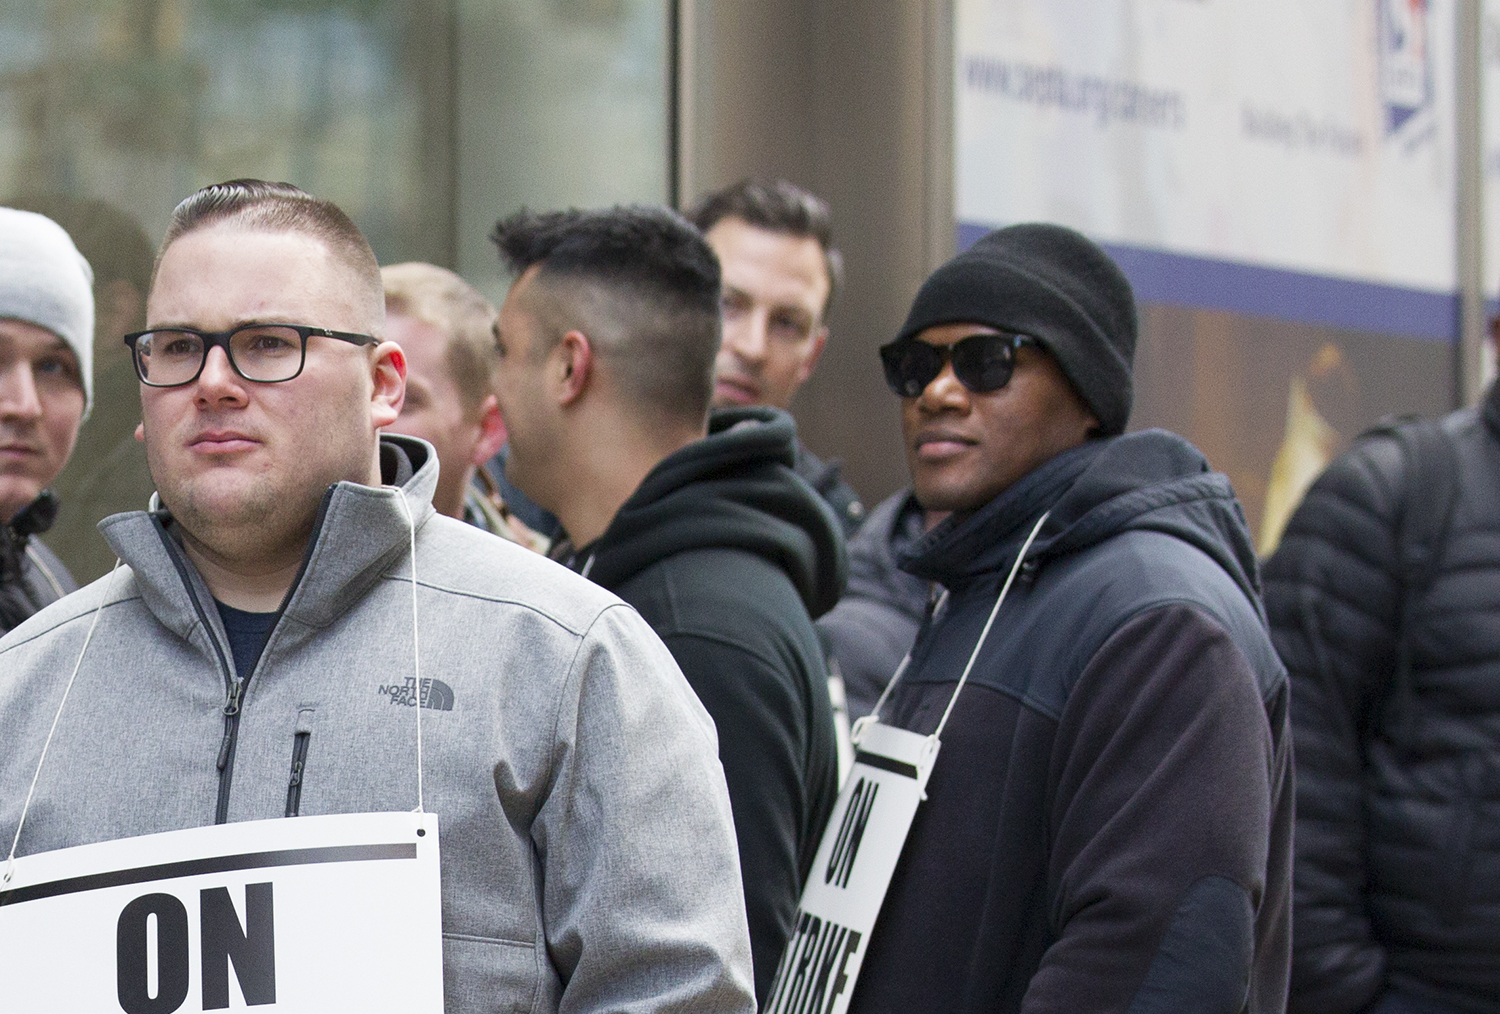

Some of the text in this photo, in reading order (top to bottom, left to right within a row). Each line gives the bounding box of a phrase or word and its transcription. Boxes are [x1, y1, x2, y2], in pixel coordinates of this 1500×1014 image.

[404, 676, 432, 688] THE
[378, 684, 429, 700] NORTH
[390, 695, 427, 708] FACE
[825, 776, 879, 889] ON
